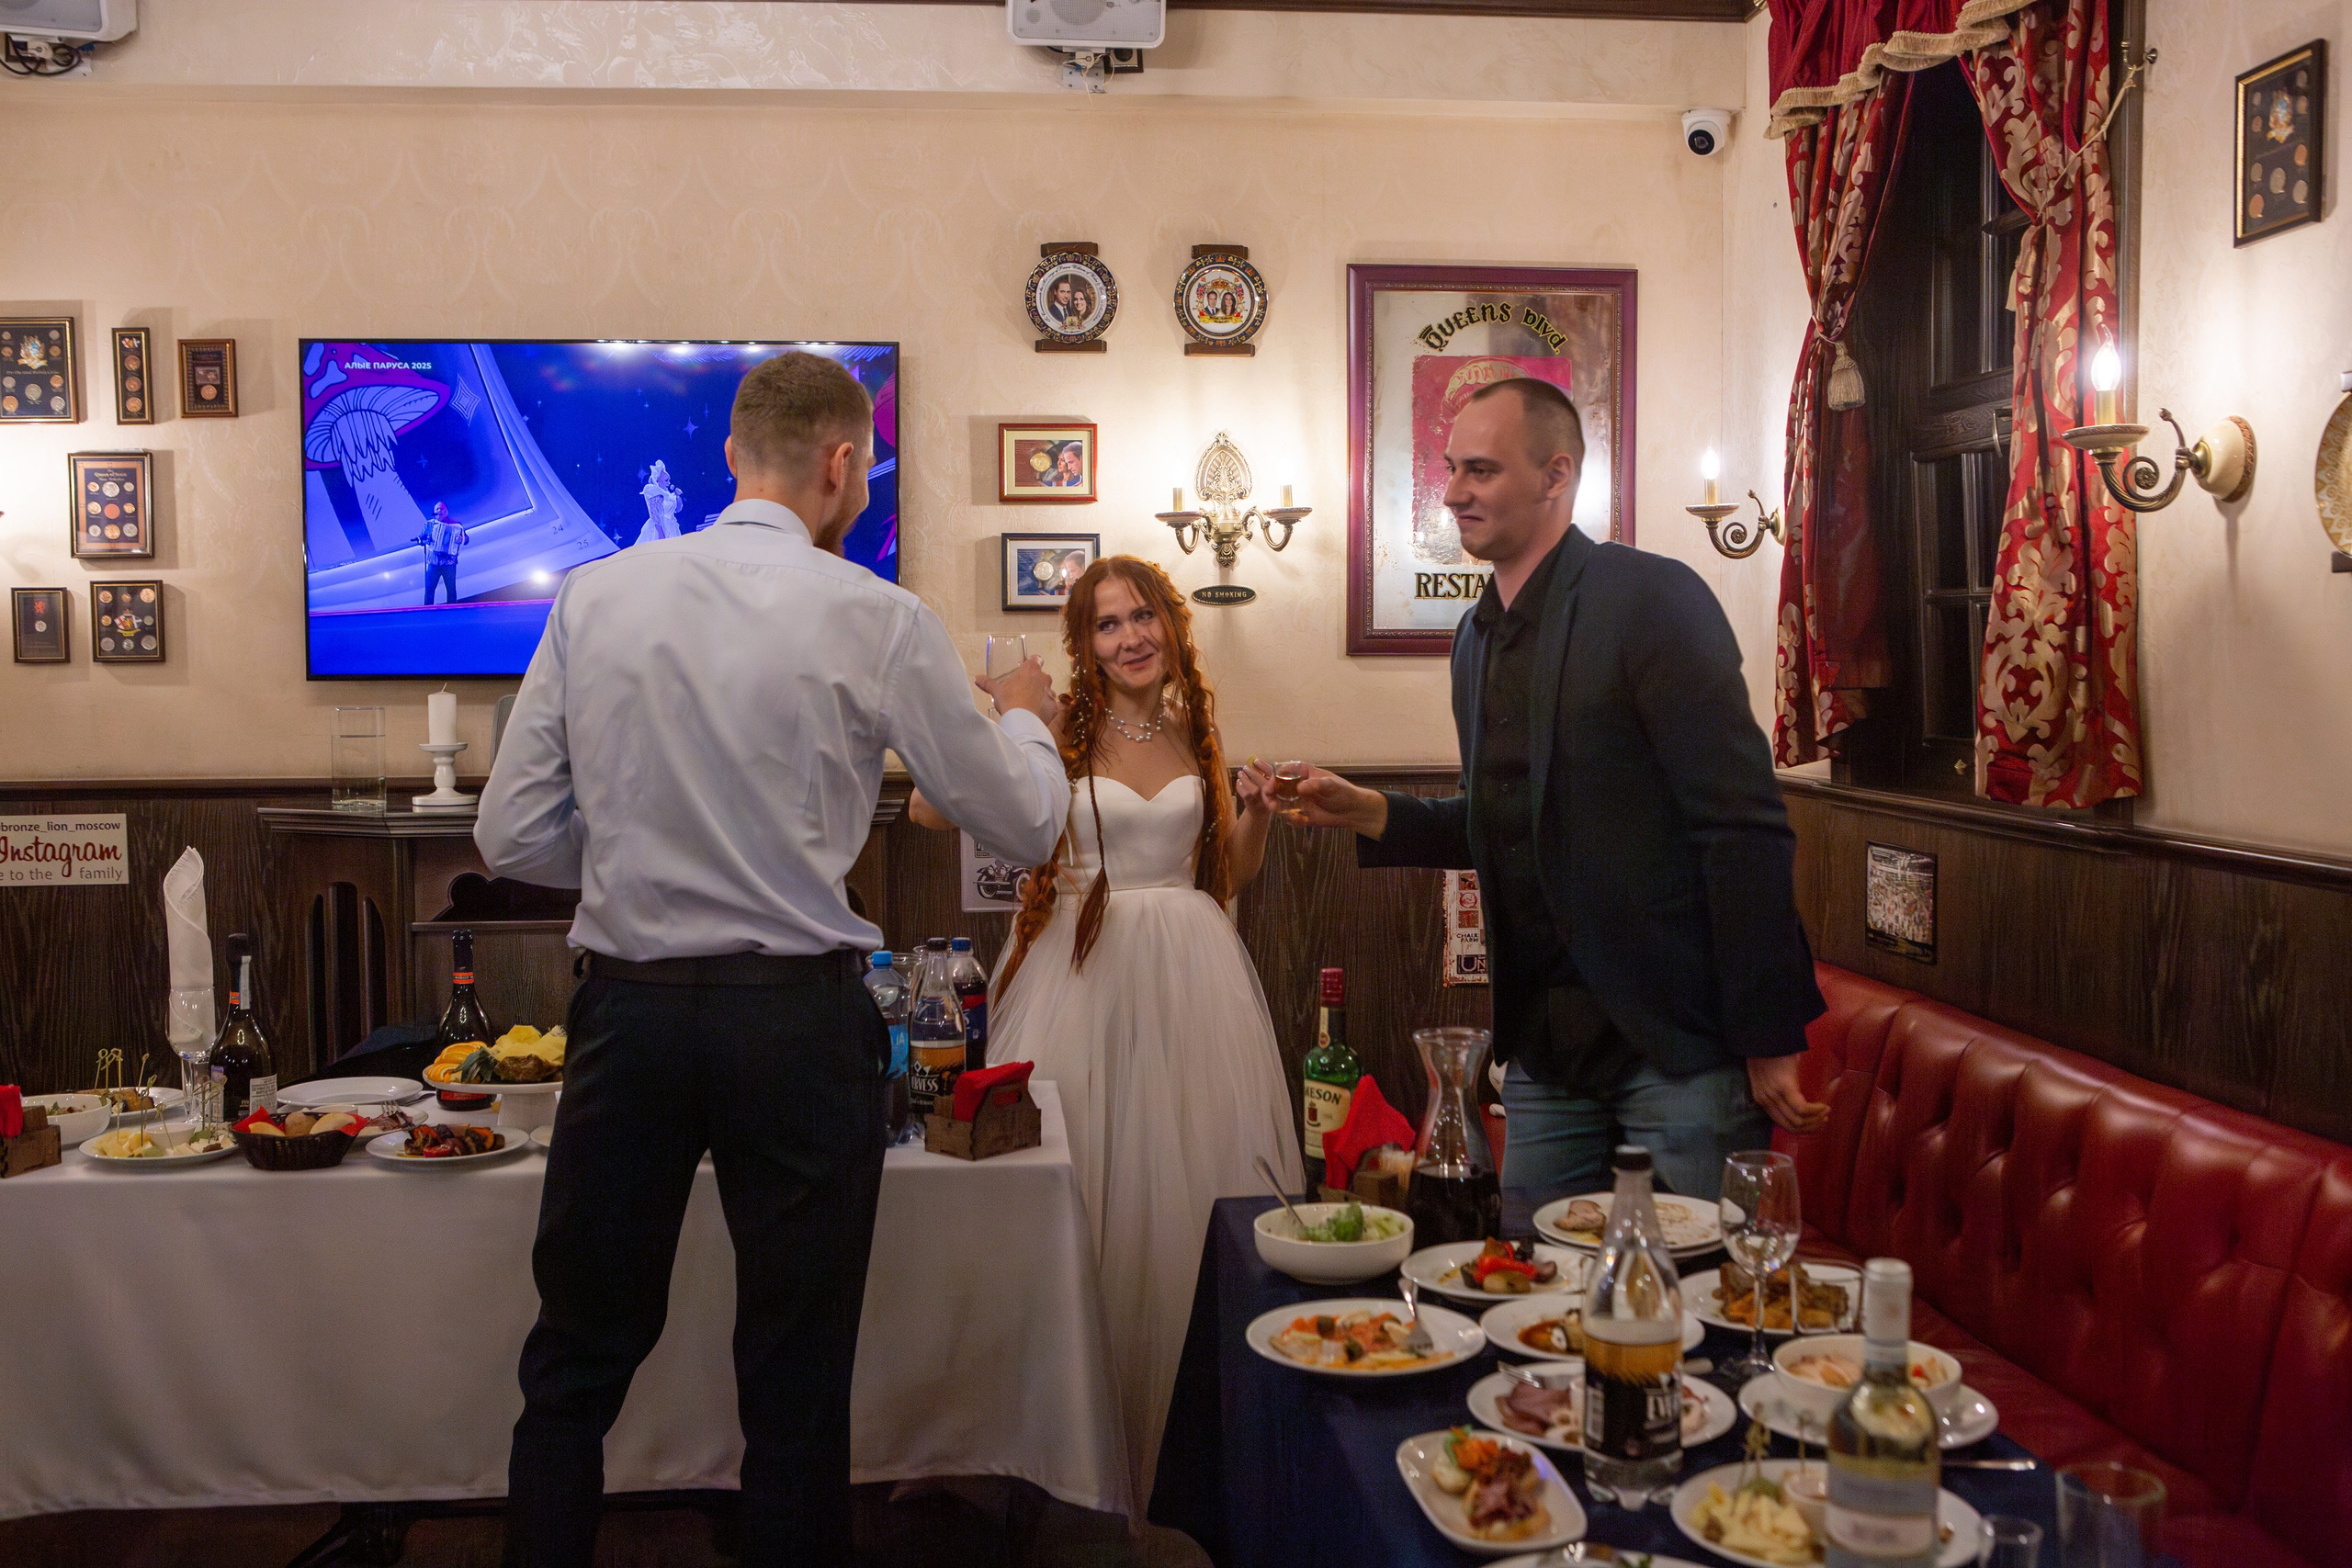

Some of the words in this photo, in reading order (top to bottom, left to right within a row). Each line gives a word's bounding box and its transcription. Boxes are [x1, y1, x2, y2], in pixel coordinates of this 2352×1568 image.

[551, 524, 564, 535] 24
[576, 539, 589, 550] 25
[1414, 572, 1492, 600] RESTA
[10, 869, 24, 881] to
[29, 868, 52, 880] the
[79, 867, 123, 882] family
[1461, 955, 1486, 972] UN
